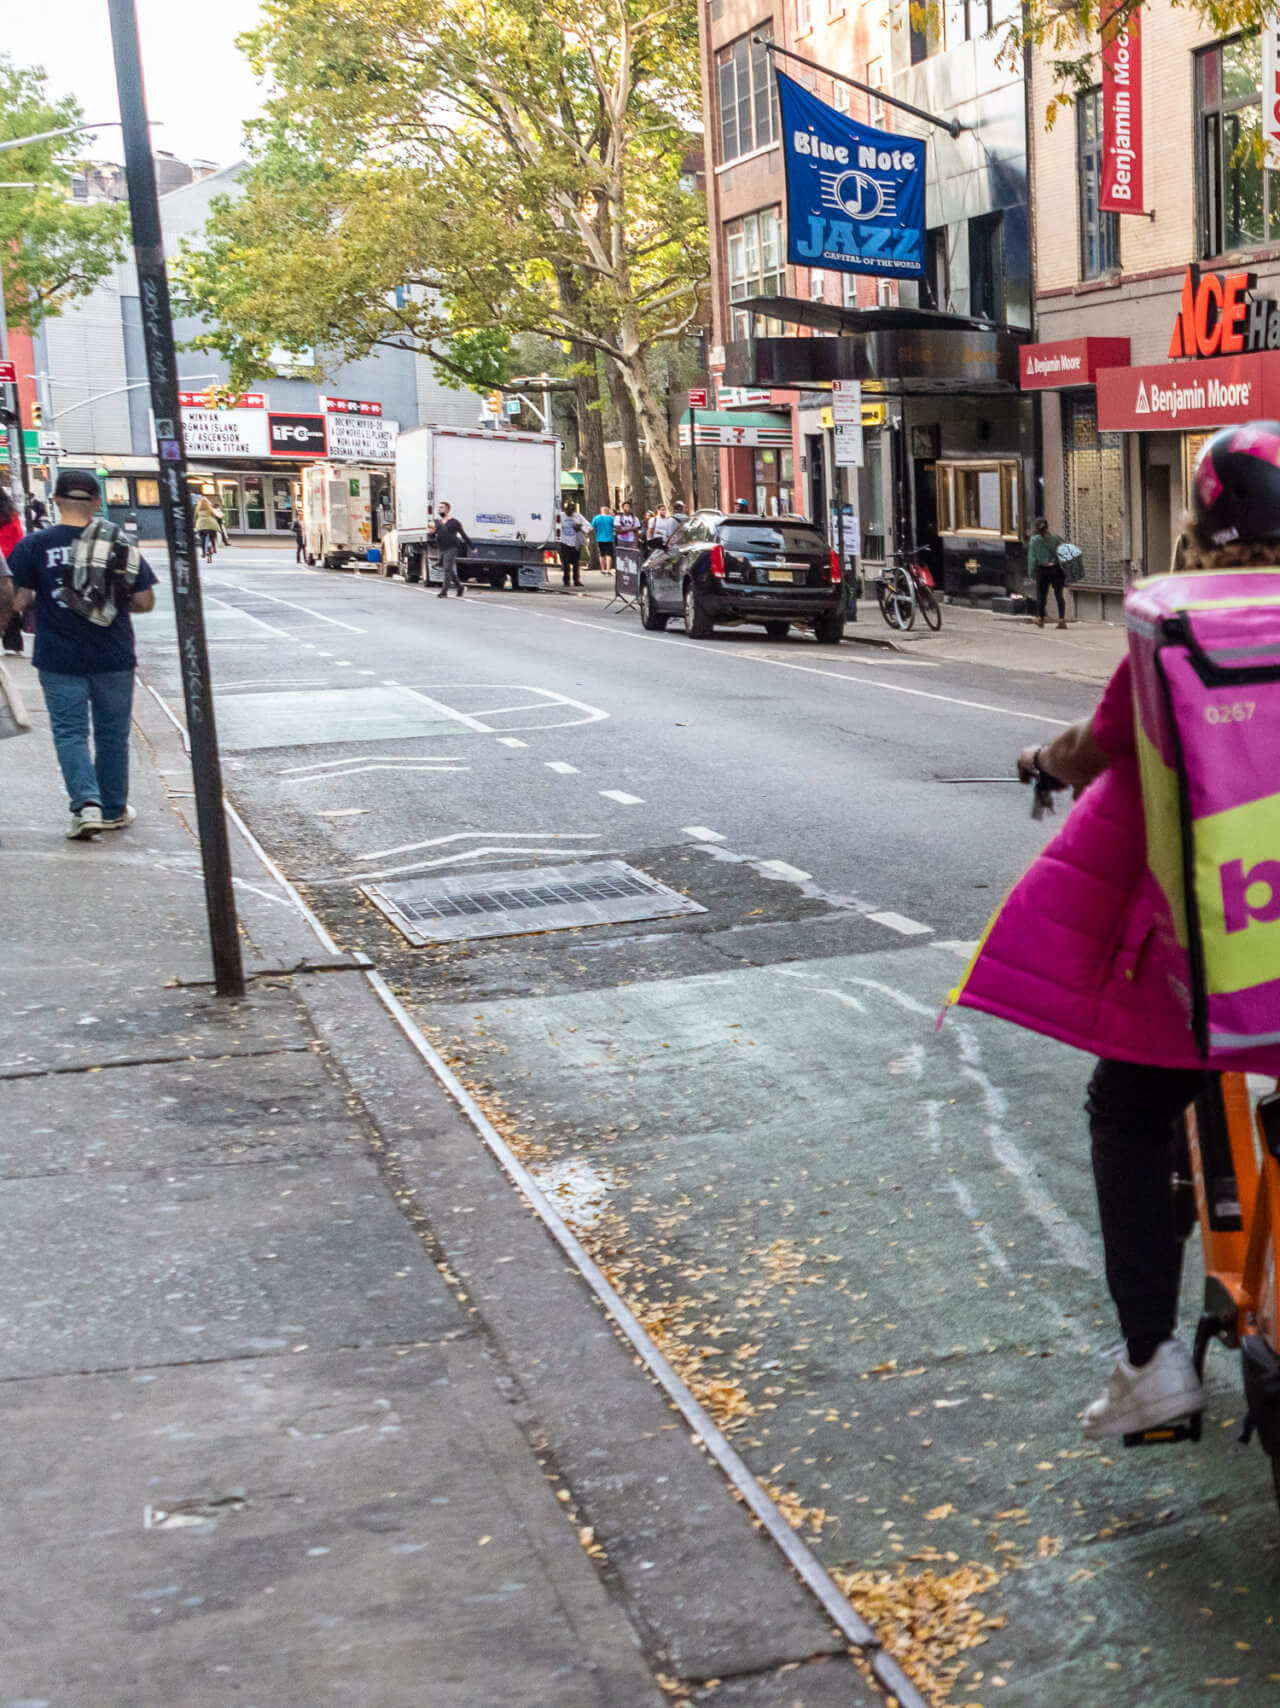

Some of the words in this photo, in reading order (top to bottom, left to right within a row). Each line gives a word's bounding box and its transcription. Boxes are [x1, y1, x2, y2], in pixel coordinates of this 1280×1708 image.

[793, 130, 850, 165] Blue
[858, 146, 915, 171] Note
[1111, 91, 1136, 200] Benjamin
[797, 215, 922, 261] JAZZ
[823, 251, 862, 264] CAPITAL
[863, 257, 876, 265] OF
[877, 259, 894, 267] THE
[894, 260, 921, 269] WORLD
[1168, 264, 1250, 358] ACE
[1034, 356, 1061, 377] Benjamin
[1061, 355, 1081, 370] Moore
[1151, 379, 1206, 418] Benjamin
[1208, 379, 1250, 408] Moore
[183, 422, 208, 431] RGMAN
[211, 423, 238, 432] ISLAND
[189, 413, 218, 421] MINYAN
[199, 433, 240, 442] ASCENSION
[732, 427, 745, 444] 7
[223, 443, 250, 453] TITANE
[1204, 702, 1256, 725] 0267
